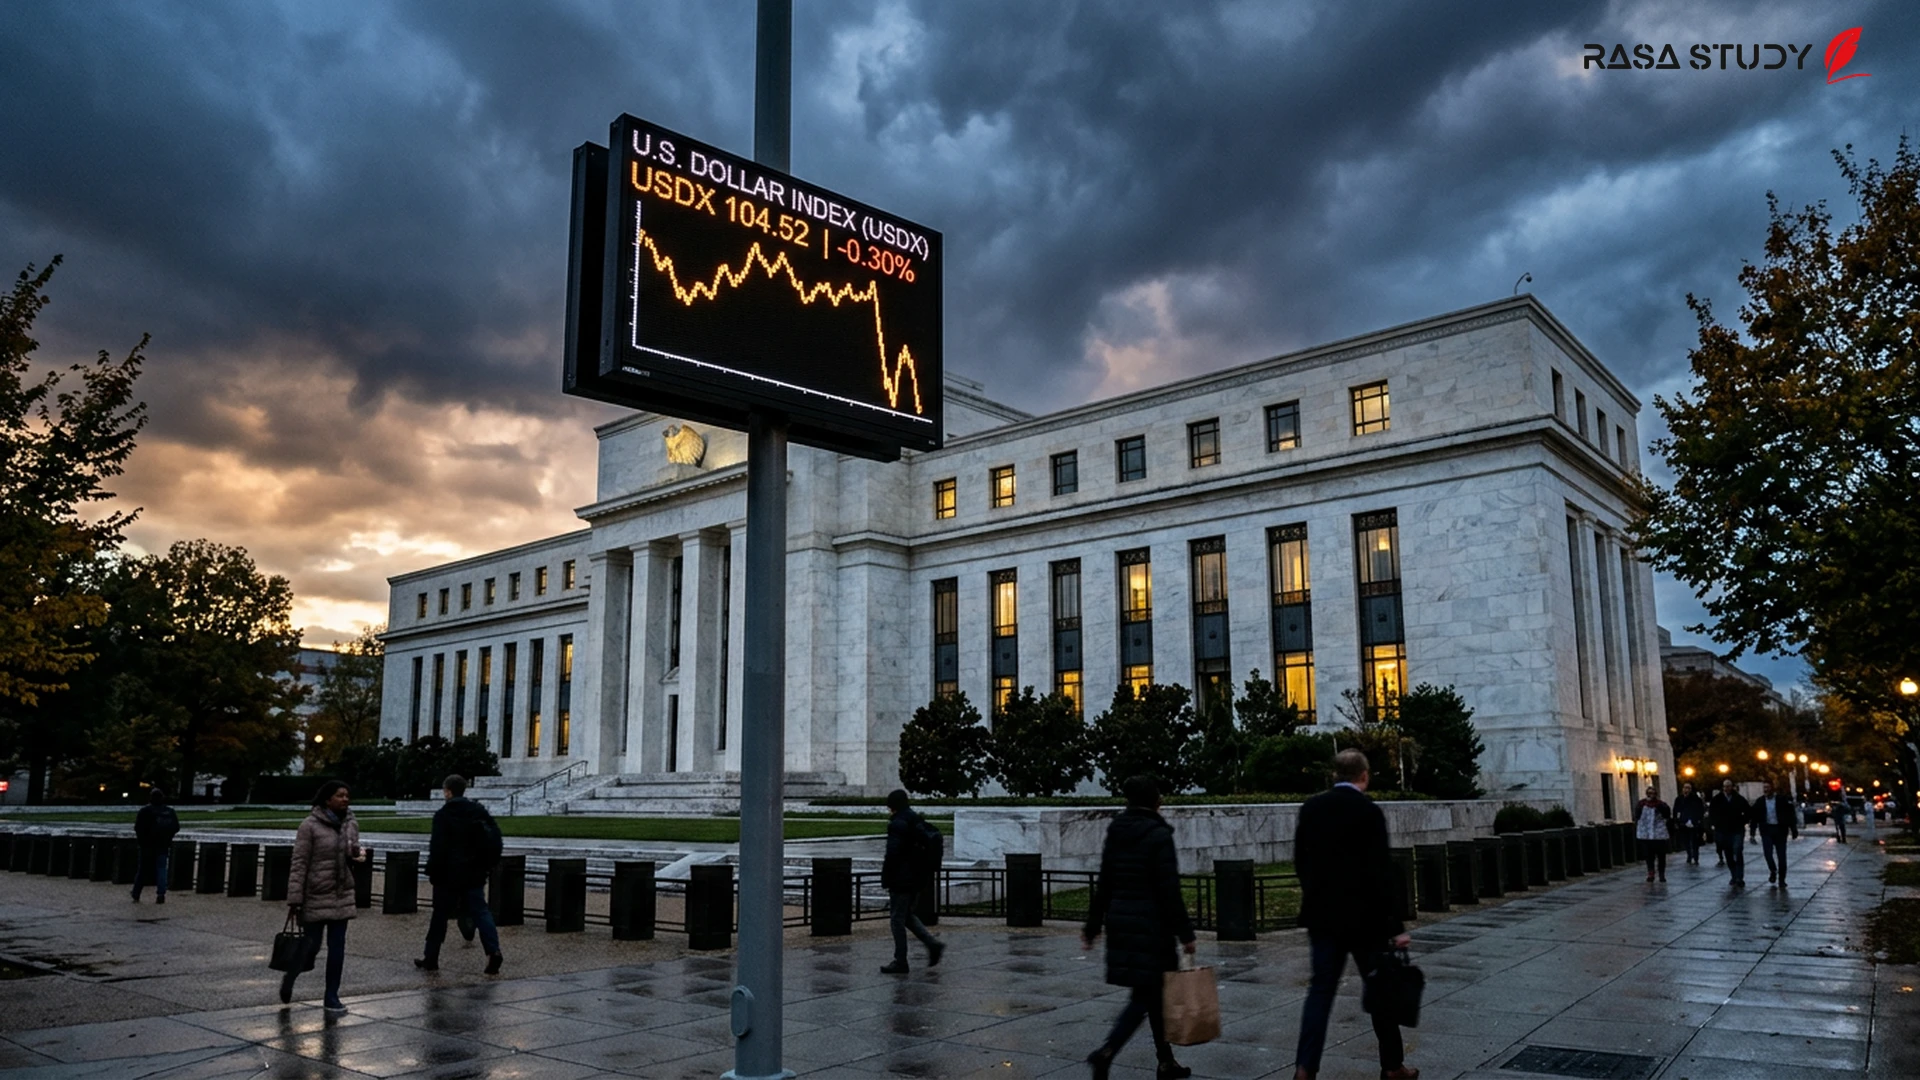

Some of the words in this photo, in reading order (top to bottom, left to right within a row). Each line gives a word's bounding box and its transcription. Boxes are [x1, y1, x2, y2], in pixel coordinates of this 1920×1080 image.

[631, 161, 716, 216] USDX
[725, 196, 809, 247] 104.52
[837, 239, 915, 283] -0.30%
[632, 129, 682, 169] U.S.
[690, 150, 785, 206] DOLLAR
[792, 189, 856, 232] INDEX
[861, 216, 929, 262] (USDX)
